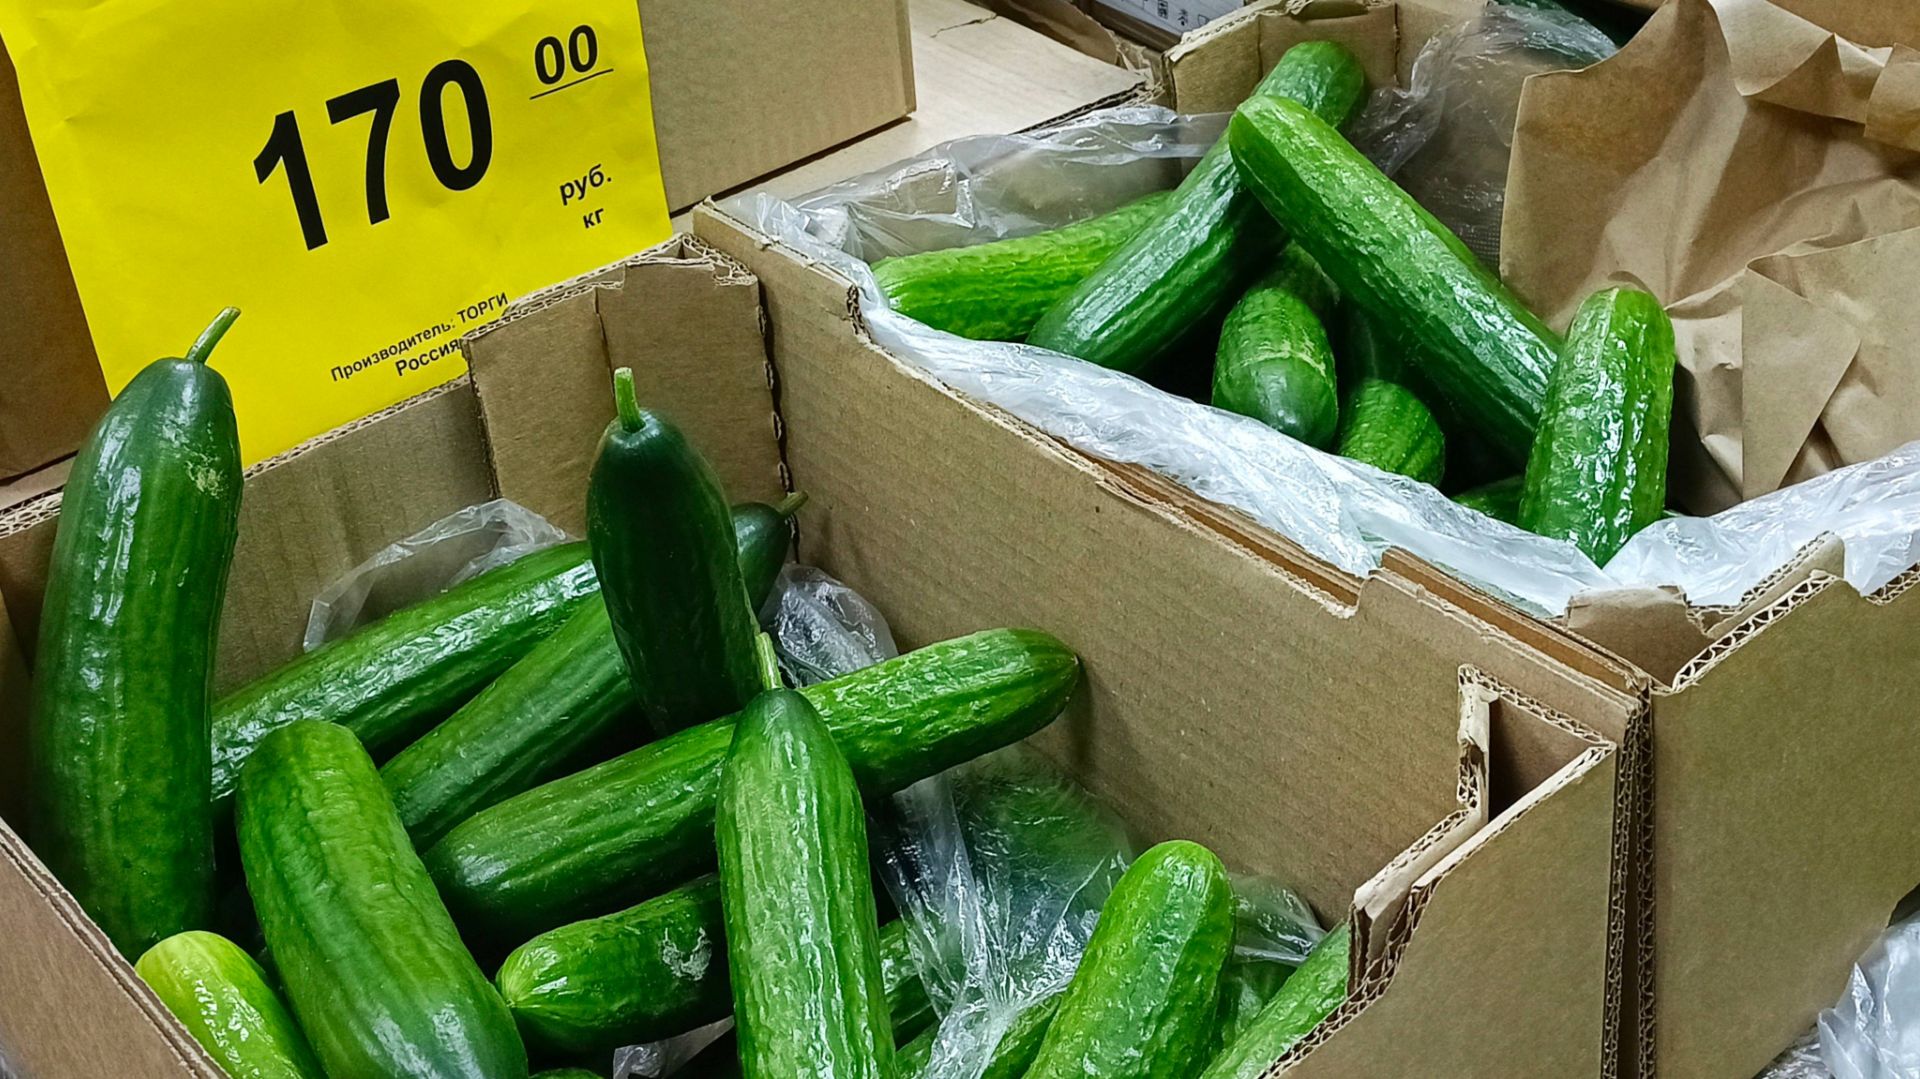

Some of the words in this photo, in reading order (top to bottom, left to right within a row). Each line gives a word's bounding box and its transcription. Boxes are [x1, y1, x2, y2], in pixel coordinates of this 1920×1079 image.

[254, 60, 493, 251] 170
[534, 24, 598, 85] 00
[559, 163, 612, 206] руб.
[583, 208, 604, 229] кг
[331, 318, 456, 382] Производитель:
[395, 338, 460, 376] Россия
